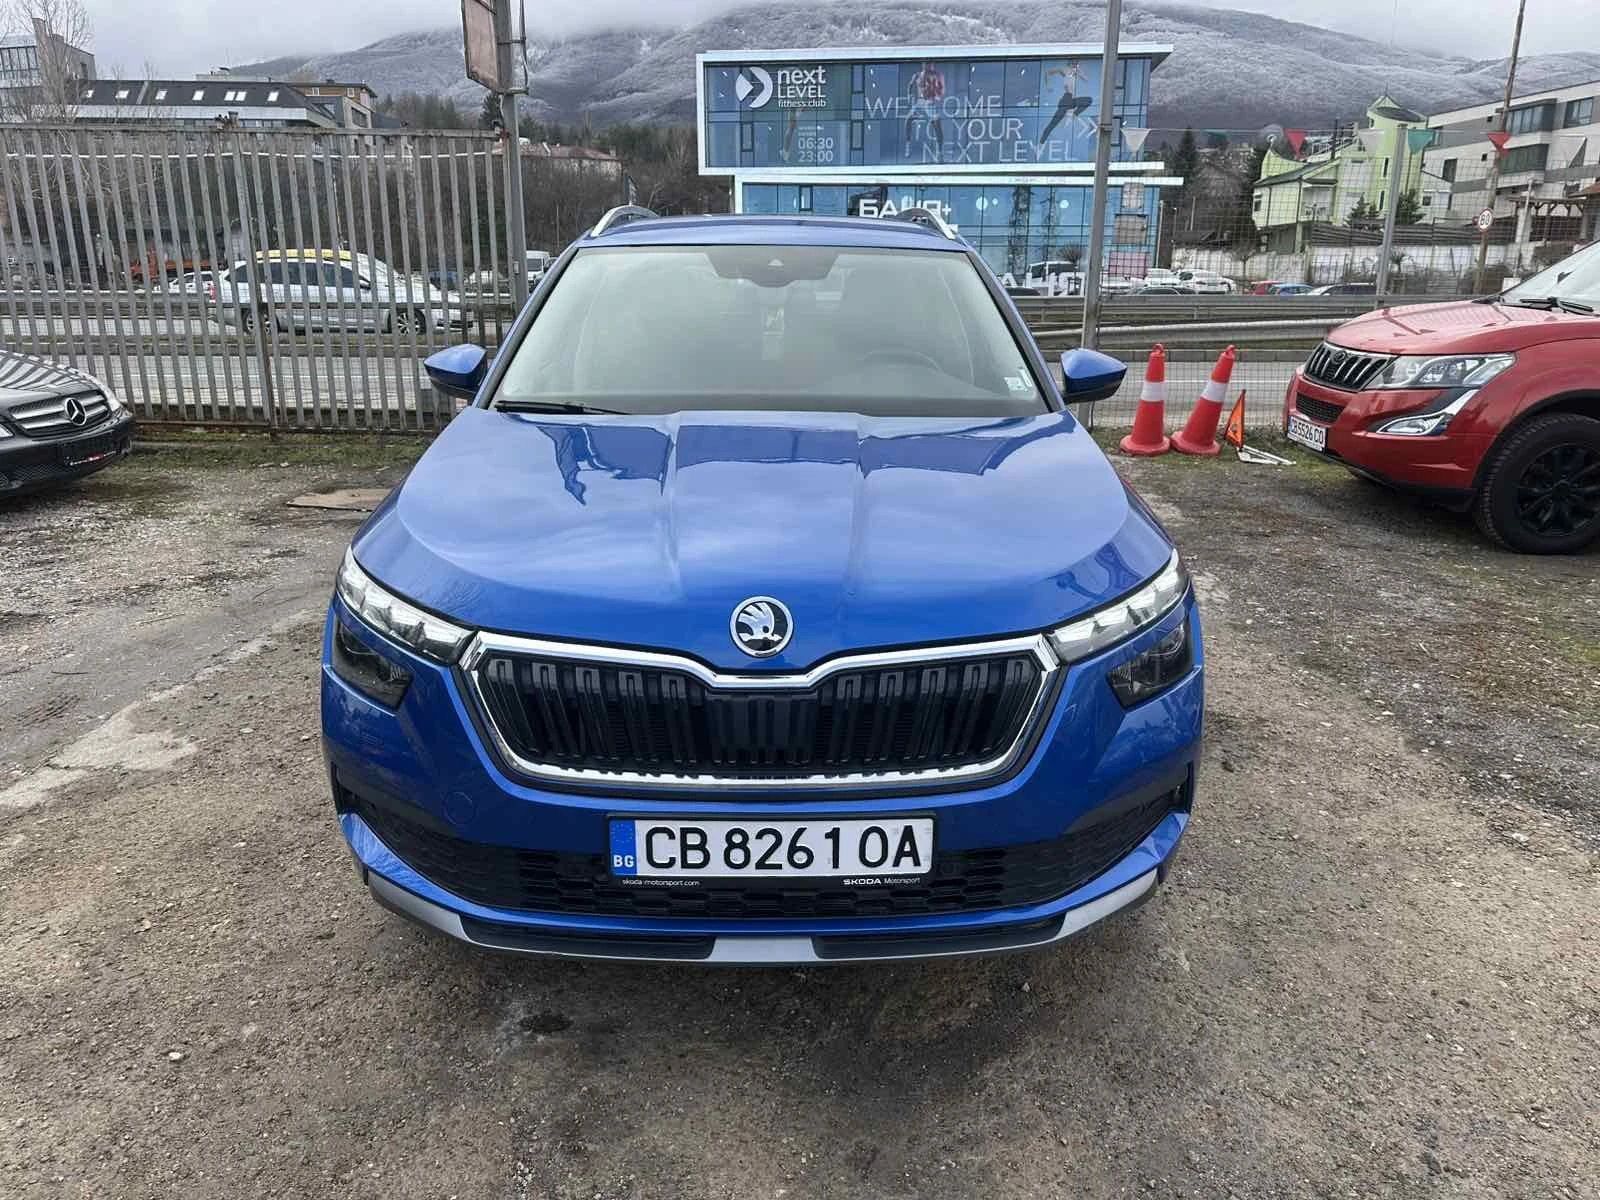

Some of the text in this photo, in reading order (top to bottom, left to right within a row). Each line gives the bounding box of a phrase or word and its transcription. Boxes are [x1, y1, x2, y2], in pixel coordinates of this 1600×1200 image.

[777, 65, 827, 84] next
[777, 85, 827, 98] LEVEL
[778, 99, 827, 108] fitness club
[953, 117, 1024, 141] YOUR
[798, 137, 834, 150] 06:30
[798, 150, 834, 162] 23:00
[922, 139, 1077, 163] NEXT LEVEL
[645, 826, 711, 869] CB
[723, 826, 841, 870] 8261
[613, 854, 635, 868] BG
[843, 876, 921, 886] SKODA Motorsport
